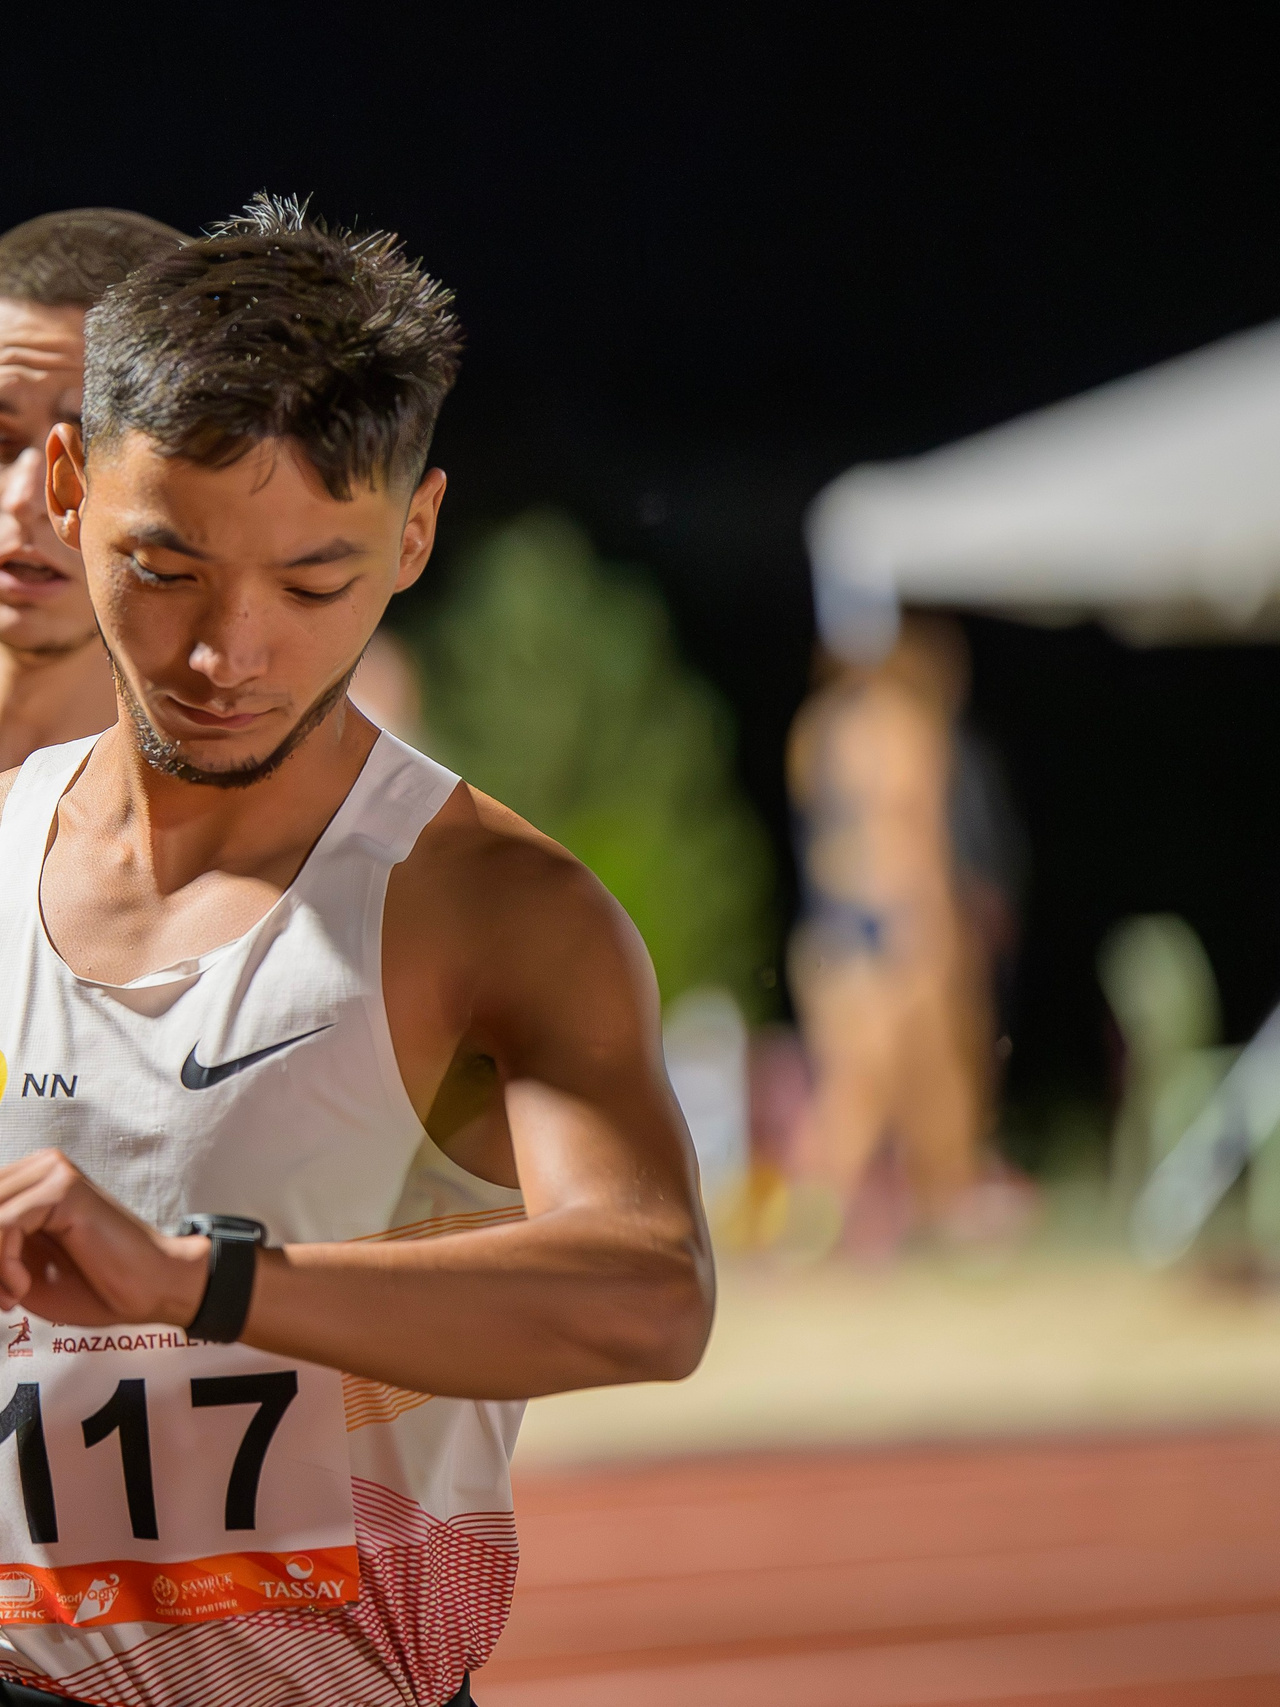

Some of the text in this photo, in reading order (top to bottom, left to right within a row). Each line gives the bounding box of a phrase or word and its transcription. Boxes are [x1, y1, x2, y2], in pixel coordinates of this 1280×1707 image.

[21, 1072, 79, 1099] NN
[52, 1332, 218, 1354] #QAZAQATHL
[258, 1579, 345, 1599] TASSAY
[155, 1598, 238, 1617] GENERAL PARTNER
